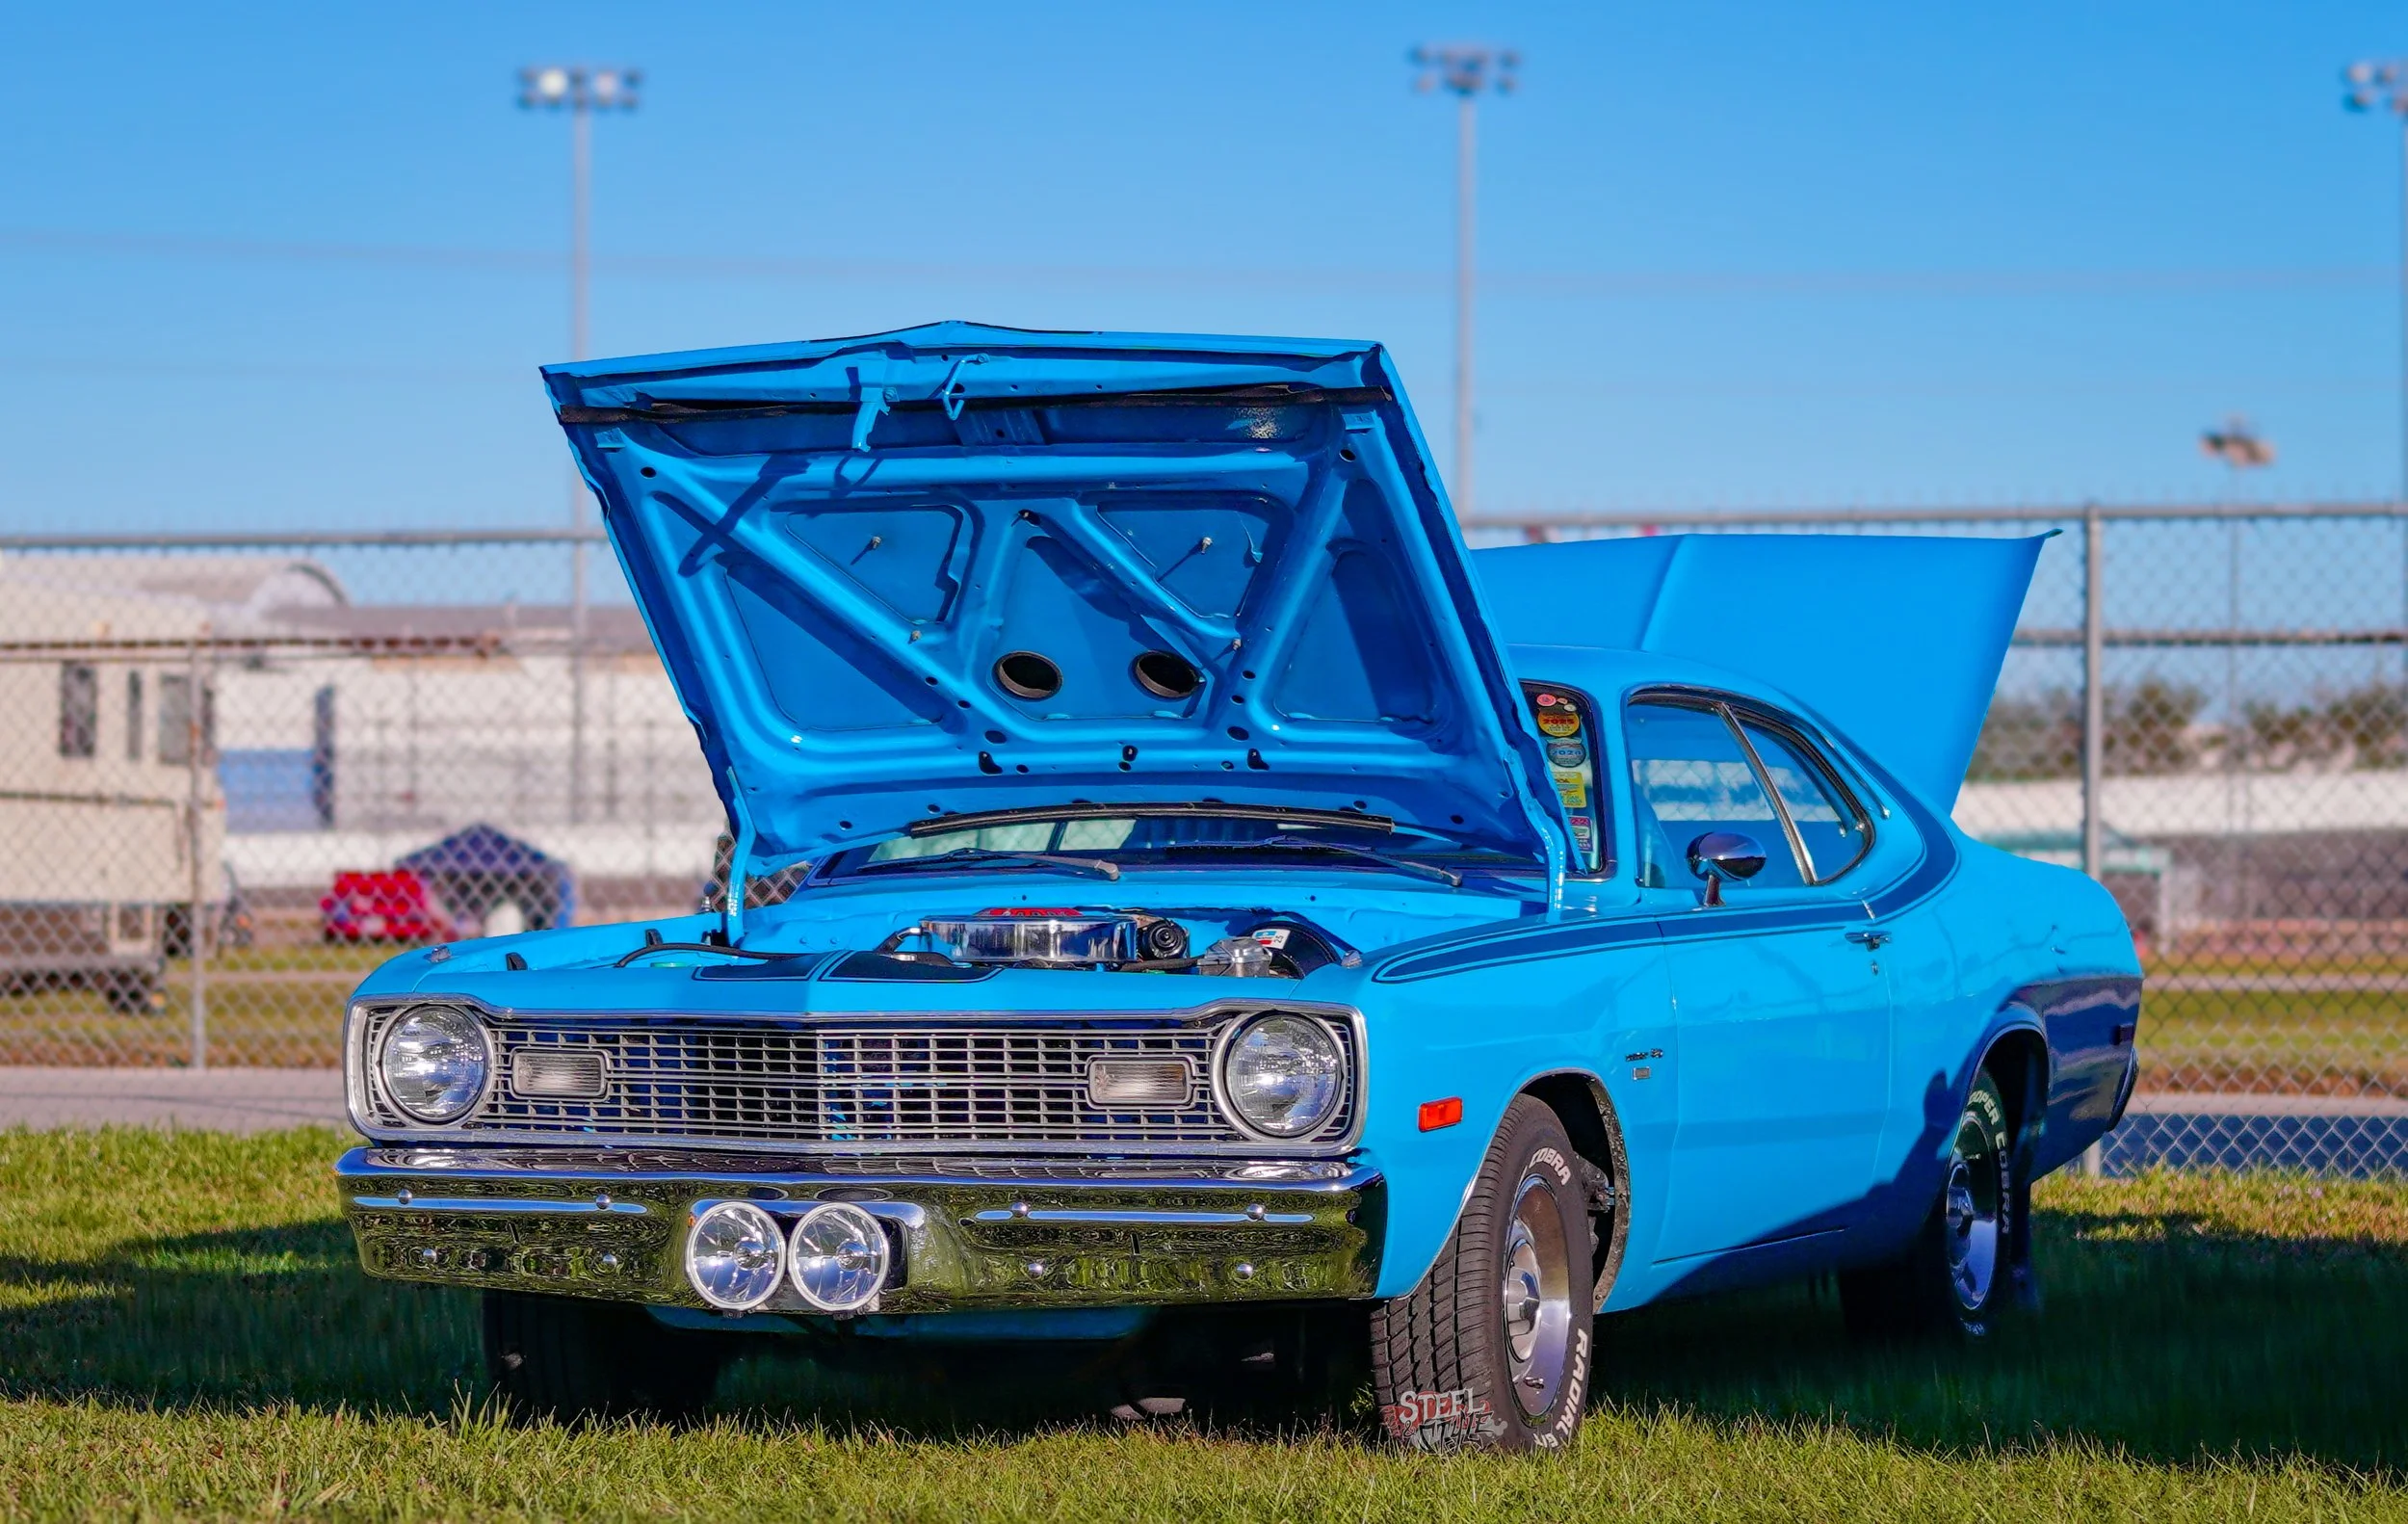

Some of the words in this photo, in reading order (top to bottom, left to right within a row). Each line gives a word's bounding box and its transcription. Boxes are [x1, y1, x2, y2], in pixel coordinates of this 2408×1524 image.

[1529, 1147, 1571, 1185] COBRA
[1995, 1131, 2010, 1234] COBRA
[1556, 1327, 1588, 1435] RADIAL
